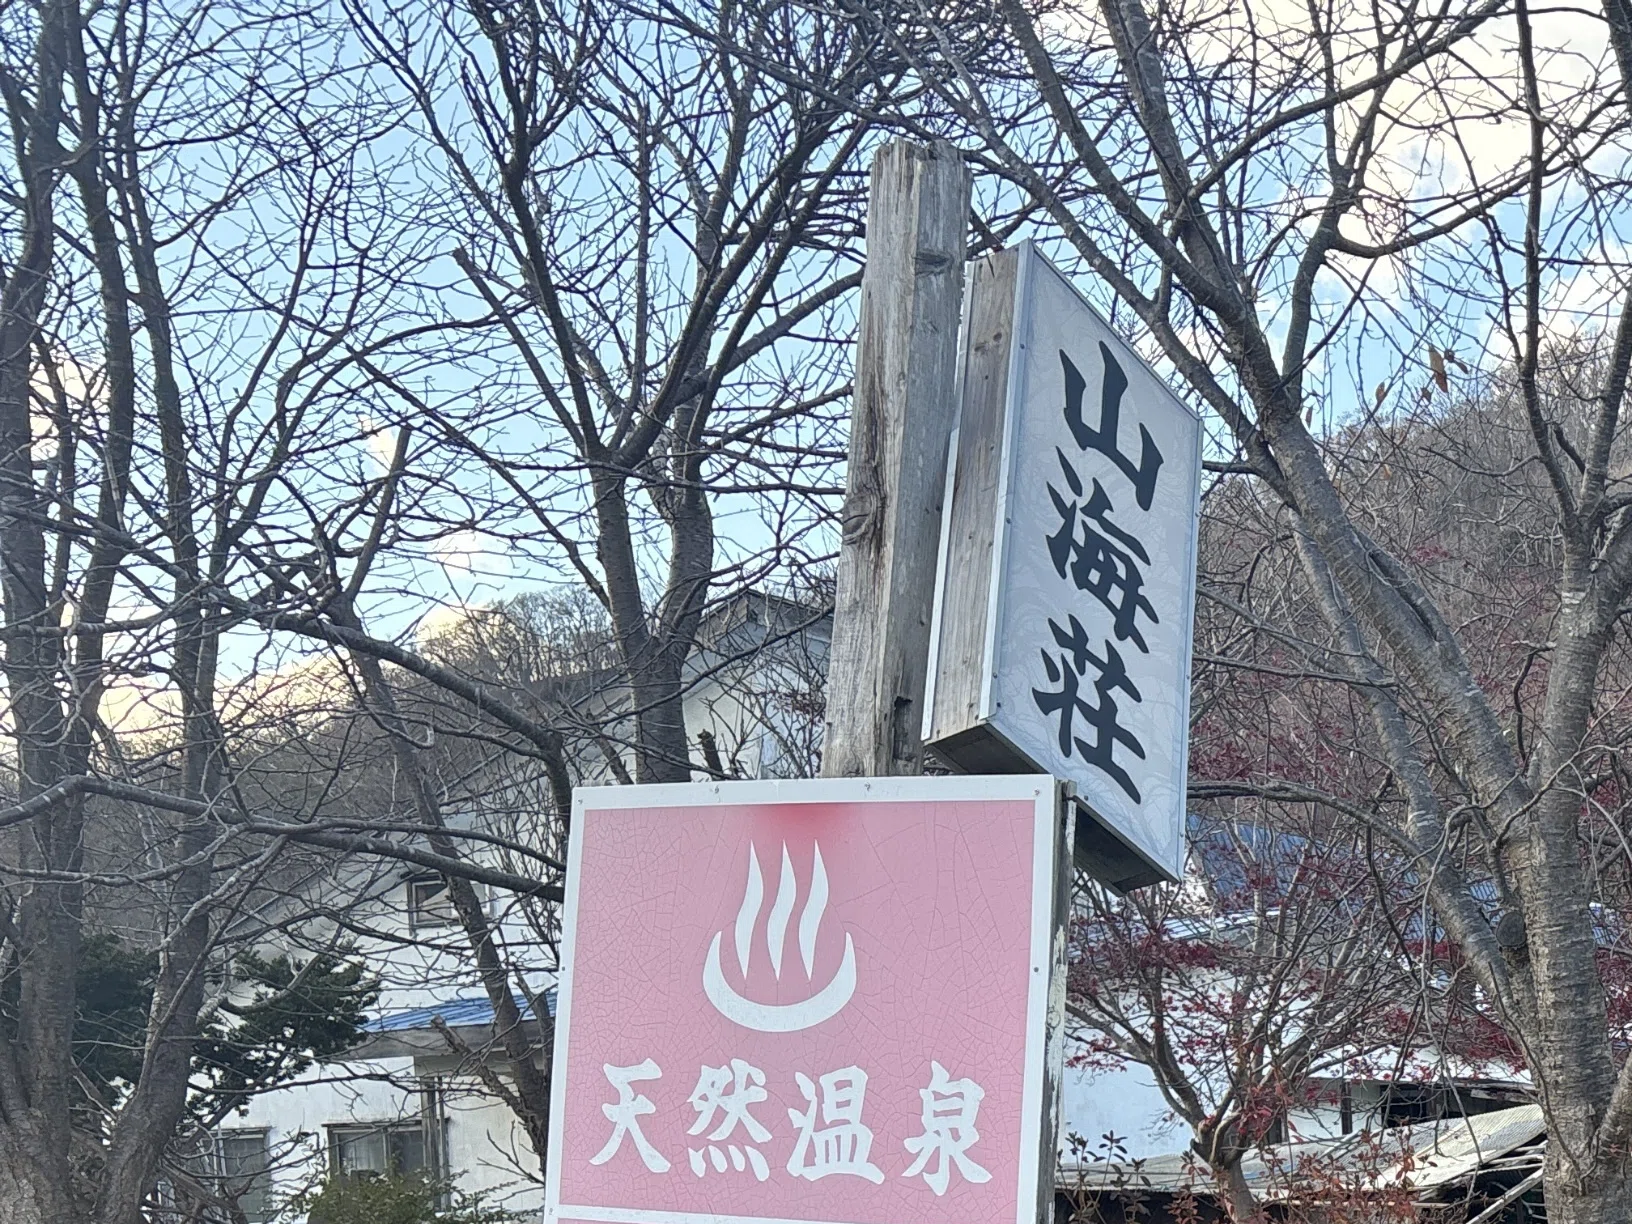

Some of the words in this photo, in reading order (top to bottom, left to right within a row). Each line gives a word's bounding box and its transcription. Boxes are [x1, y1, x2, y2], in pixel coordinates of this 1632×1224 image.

[1031, 340, 1165, 805] 山海荘
[589, 1058, 993, 1196] 天然温泉
